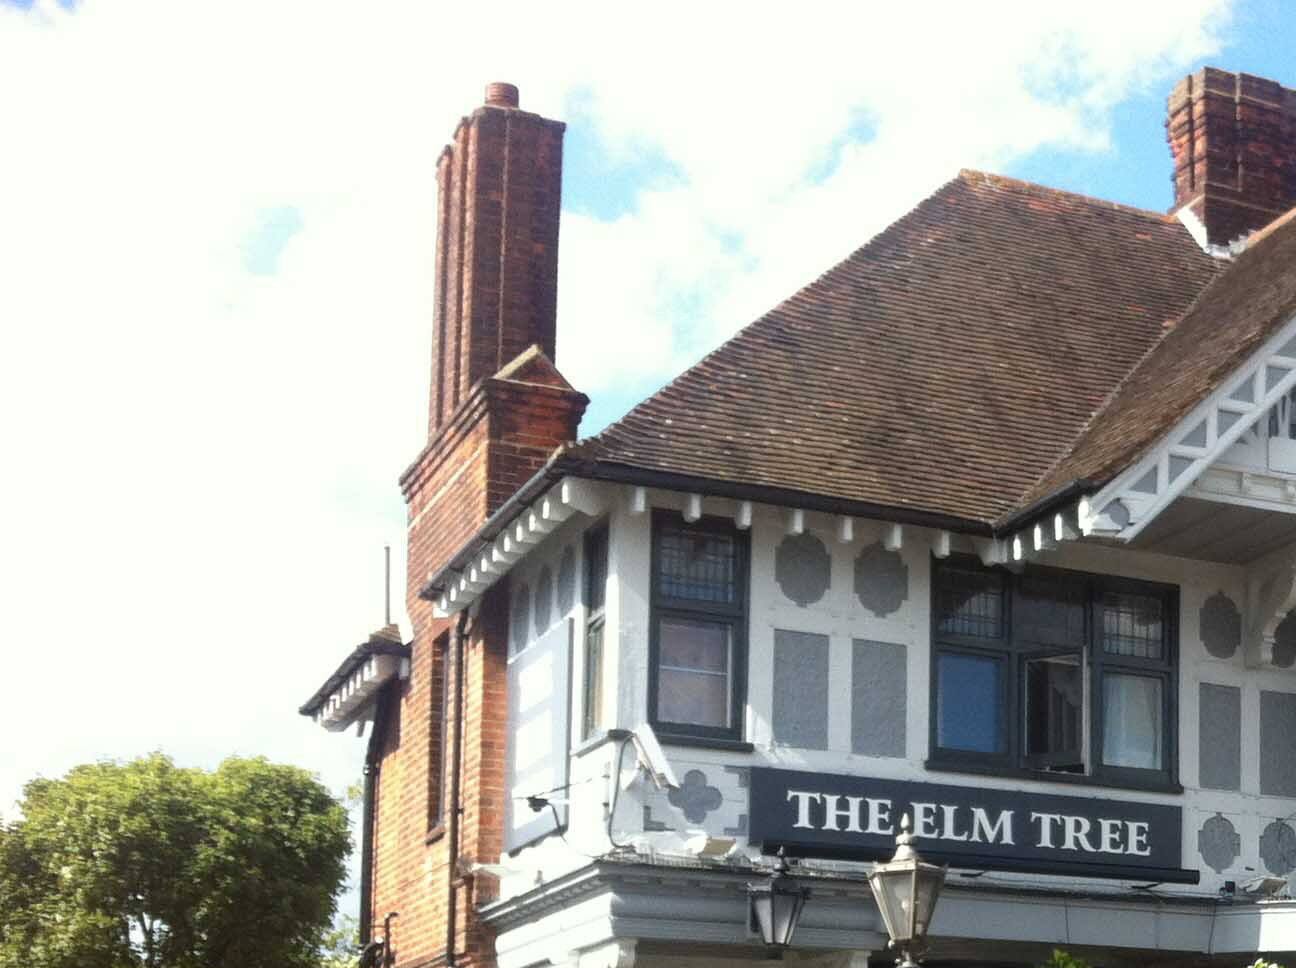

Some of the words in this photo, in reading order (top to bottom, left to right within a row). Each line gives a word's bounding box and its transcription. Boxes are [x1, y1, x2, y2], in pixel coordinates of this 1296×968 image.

[786, 789, 893, 836] THE
[912, 801, 1014, 846] ELM
[1030, 811, 1151, 857] TREE
